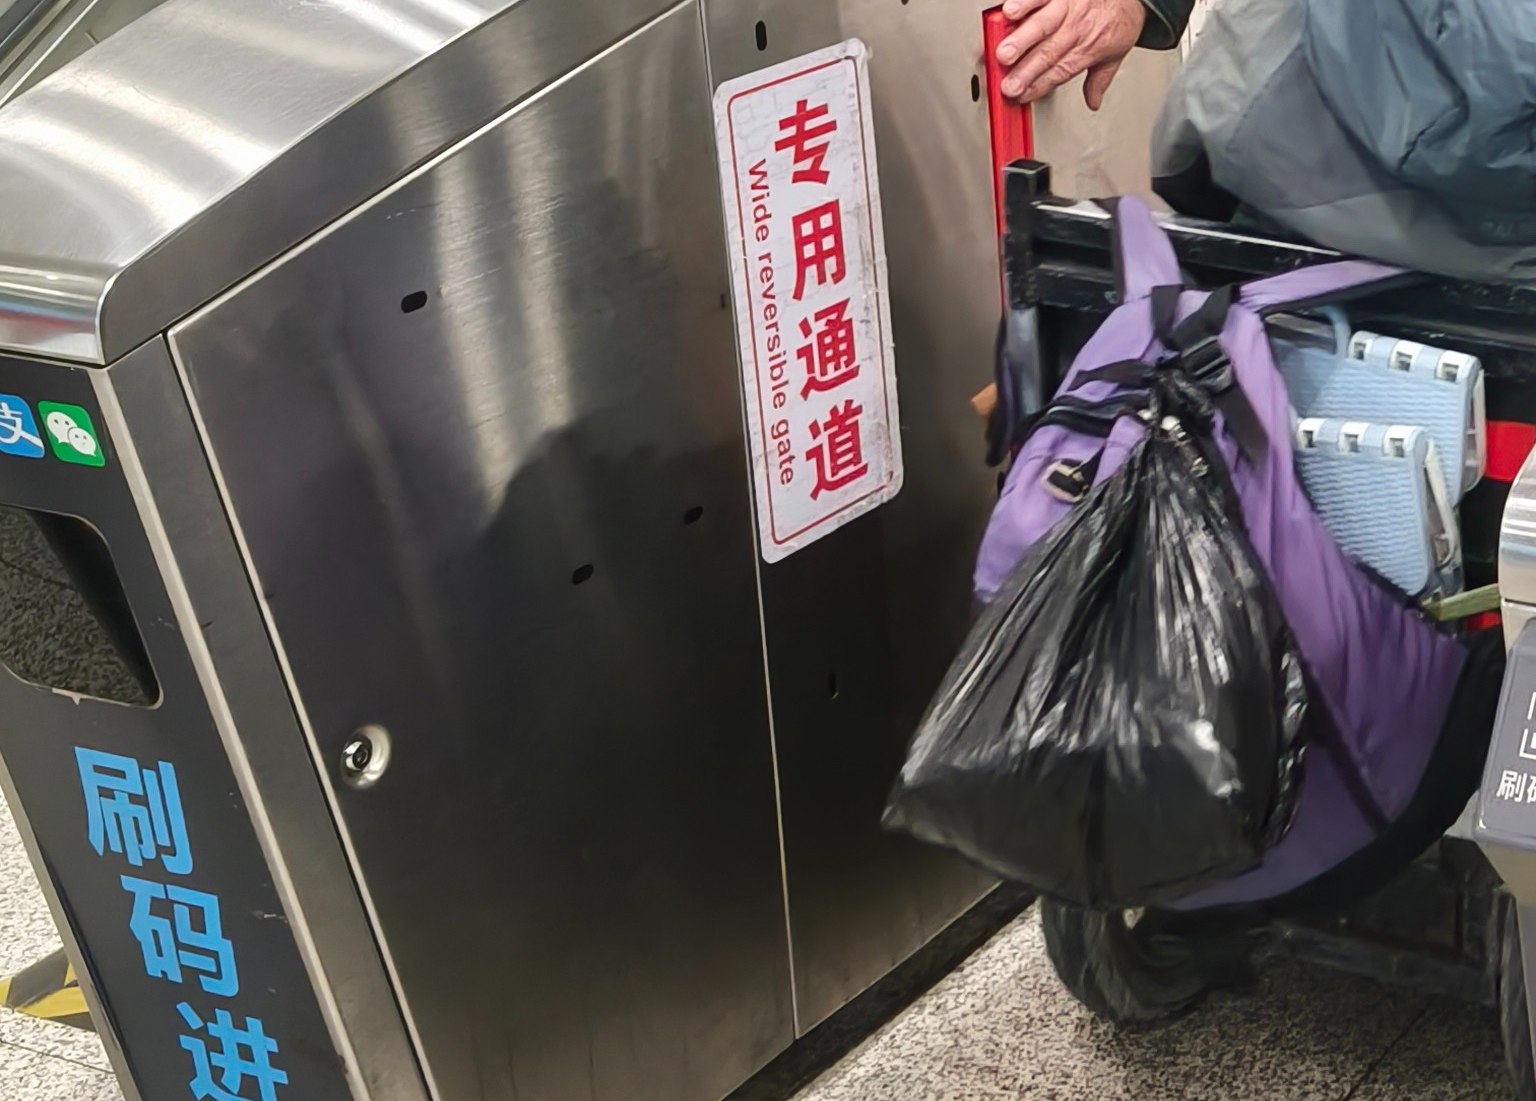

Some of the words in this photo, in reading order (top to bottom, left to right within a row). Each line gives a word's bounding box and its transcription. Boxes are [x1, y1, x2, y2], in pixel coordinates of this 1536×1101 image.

[748, 157, 773, 243] Wide
[757, 251, 791, 410] reversible
[774, 98, 869, 502] 专用通道
[770, 420, 794, 487] gate
[73, 746, 290, 1101] 刷码进
